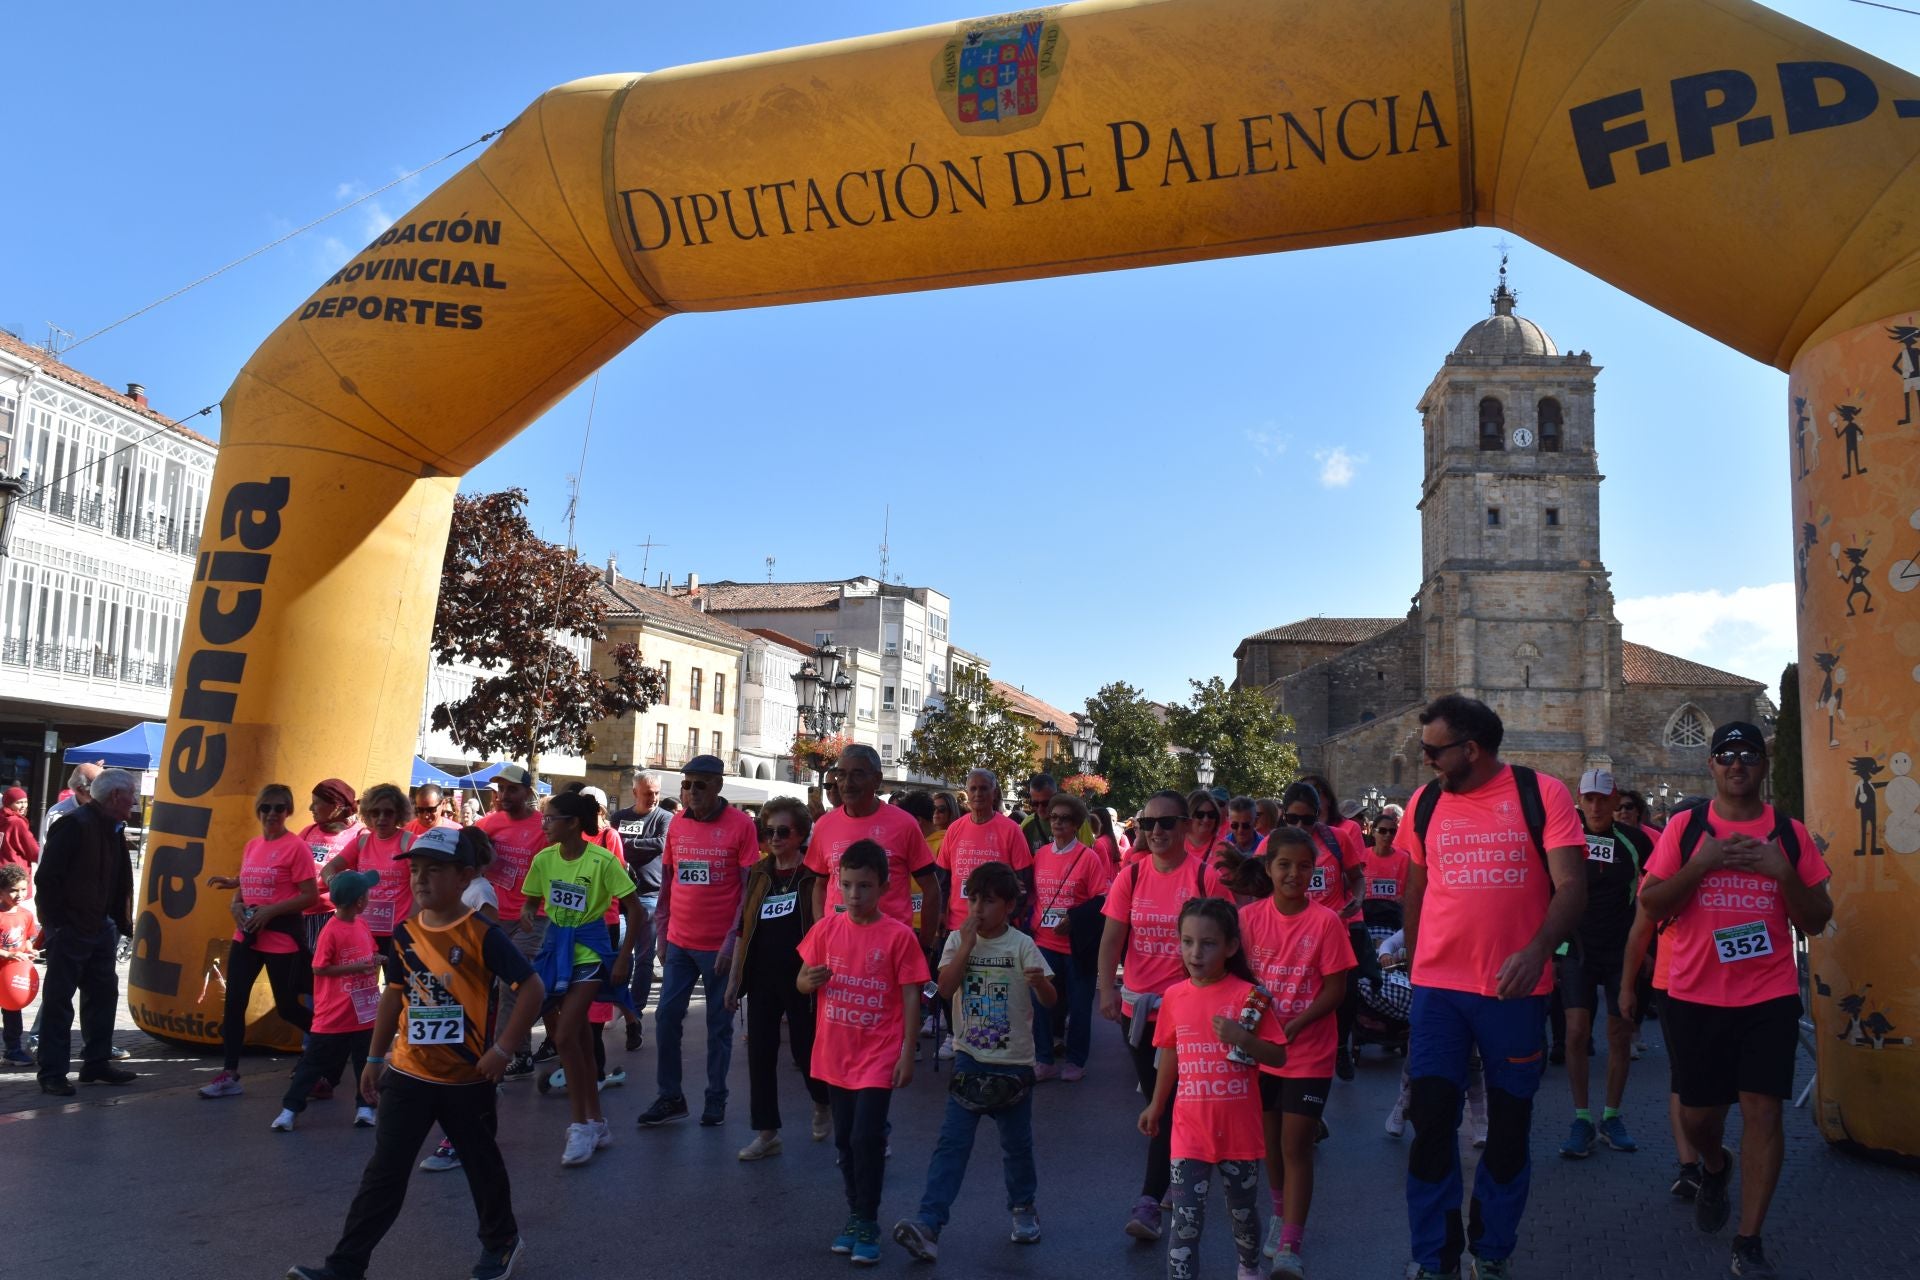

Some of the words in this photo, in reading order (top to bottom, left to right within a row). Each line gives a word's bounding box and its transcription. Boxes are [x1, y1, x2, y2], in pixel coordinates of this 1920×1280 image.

[618, 142, 987, 253] DIPUTACIÓN
[1003, 142, 1092, 207] DE
[1106, 89, 1452, 193] PALENCIA
[323, 258, 507, 290] ROVINCIAL
[298, 295, 484, 331] DEPORTES
[128, 476, 291, 997] Palencia
[1441, 833, 1461, 846] En
[1465, 828, 1528, 844] marcha
[678, 845, 688, 855] En
[690, 847, 728, 857] marcha
[1443, 847, 1506, 865] contra
[1509, 845, 1527, 862] el
[240, 875, 261, 885] ontra
[680, 869, 708, 882] 463
[1445, 865, 1528, 885] cáncer
[242, 884, 276, 897] áncer
[368, 889, 401, 898] ncer
[1374, 884, 1395, 894] 116
[1761, 879, 1778, 893] el
[552, 890, 583, 908] 387
[1701, 888, 1775, 910] cáncer
[372, 907, 392, 918] 245
[763, 901, 793, 916] 464
[1131, 909, 1143, 921] En
[1135, 937, 1183, 955] cánce
[1720, 934, 1769, 959] 352
[967, 956, 1015, 968] INECRAFT
[835, 973, 887, 991] marcha
[1264, 977, 1297, 994] ntra
[826, 987, 865, 1006] ontra
[867, 993, 884, 1009] el
[1272, 997, 1314, 1013] ncer
[826, 1000, 882, 1026] áncer
[412, 1020, 461, 1041] 372
